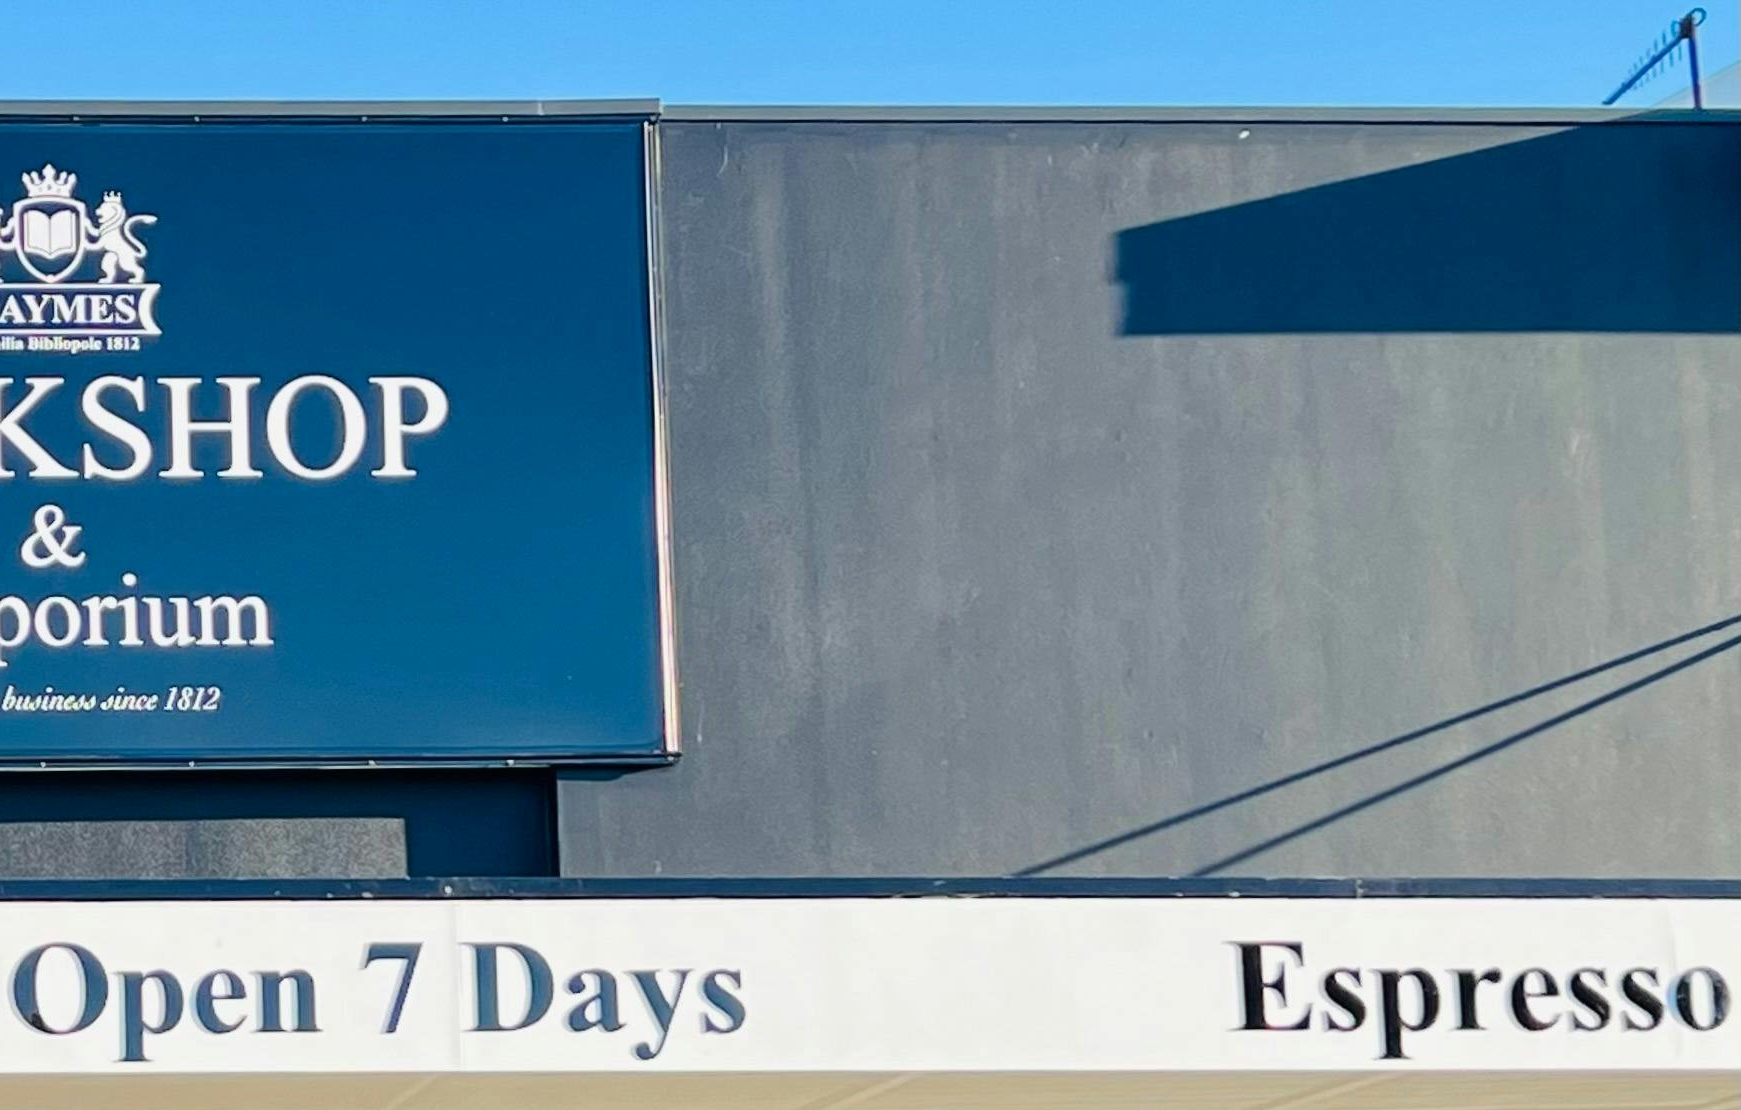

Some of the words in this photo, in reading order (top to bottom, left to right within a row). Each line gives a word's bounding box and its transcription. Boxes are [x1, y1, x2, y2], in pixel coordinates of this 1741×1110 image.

[106, 336, 141, 351] 1812
[20, 504, 86, 567] &
[1, 685, 97, 712] business
[99, 686, 159, 712] since
[163, 686, 221, 712] 1812
[8, 941, 324, 1062] Open
[360, 941, 424, 1035] 7
[462, 941, 747, 1062] Days
[1226, 940, 1731, 1060] Espresso
